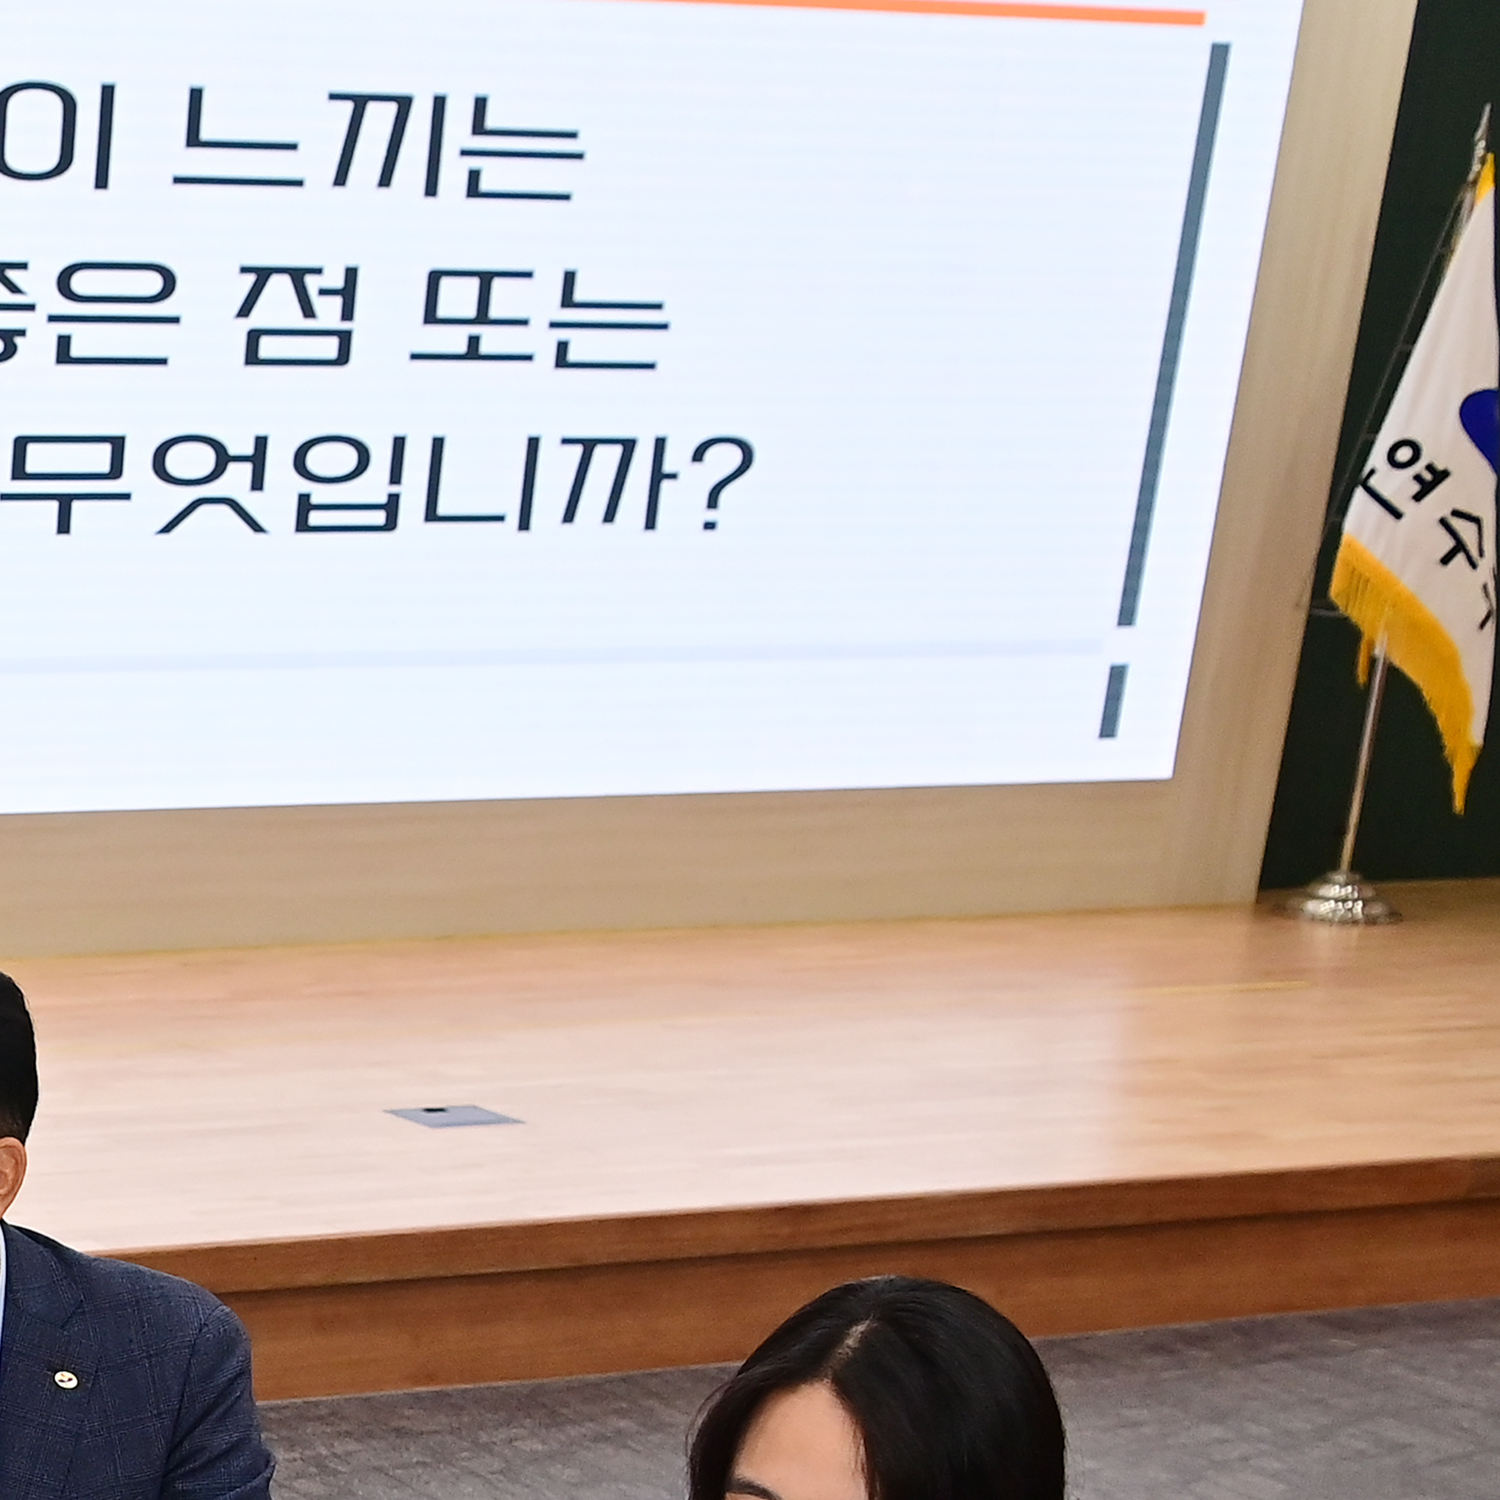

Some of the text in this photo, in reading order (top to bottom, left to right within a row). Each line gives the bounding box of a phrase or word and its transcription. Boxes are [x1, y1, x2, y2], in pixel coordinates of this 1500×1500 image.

[172, 84, 586, 203] 느끼는
[234, 262, 356, 369] 점
[409, 266, 670, 372] 또는
[1361, 436, 1497, 631] 연수
